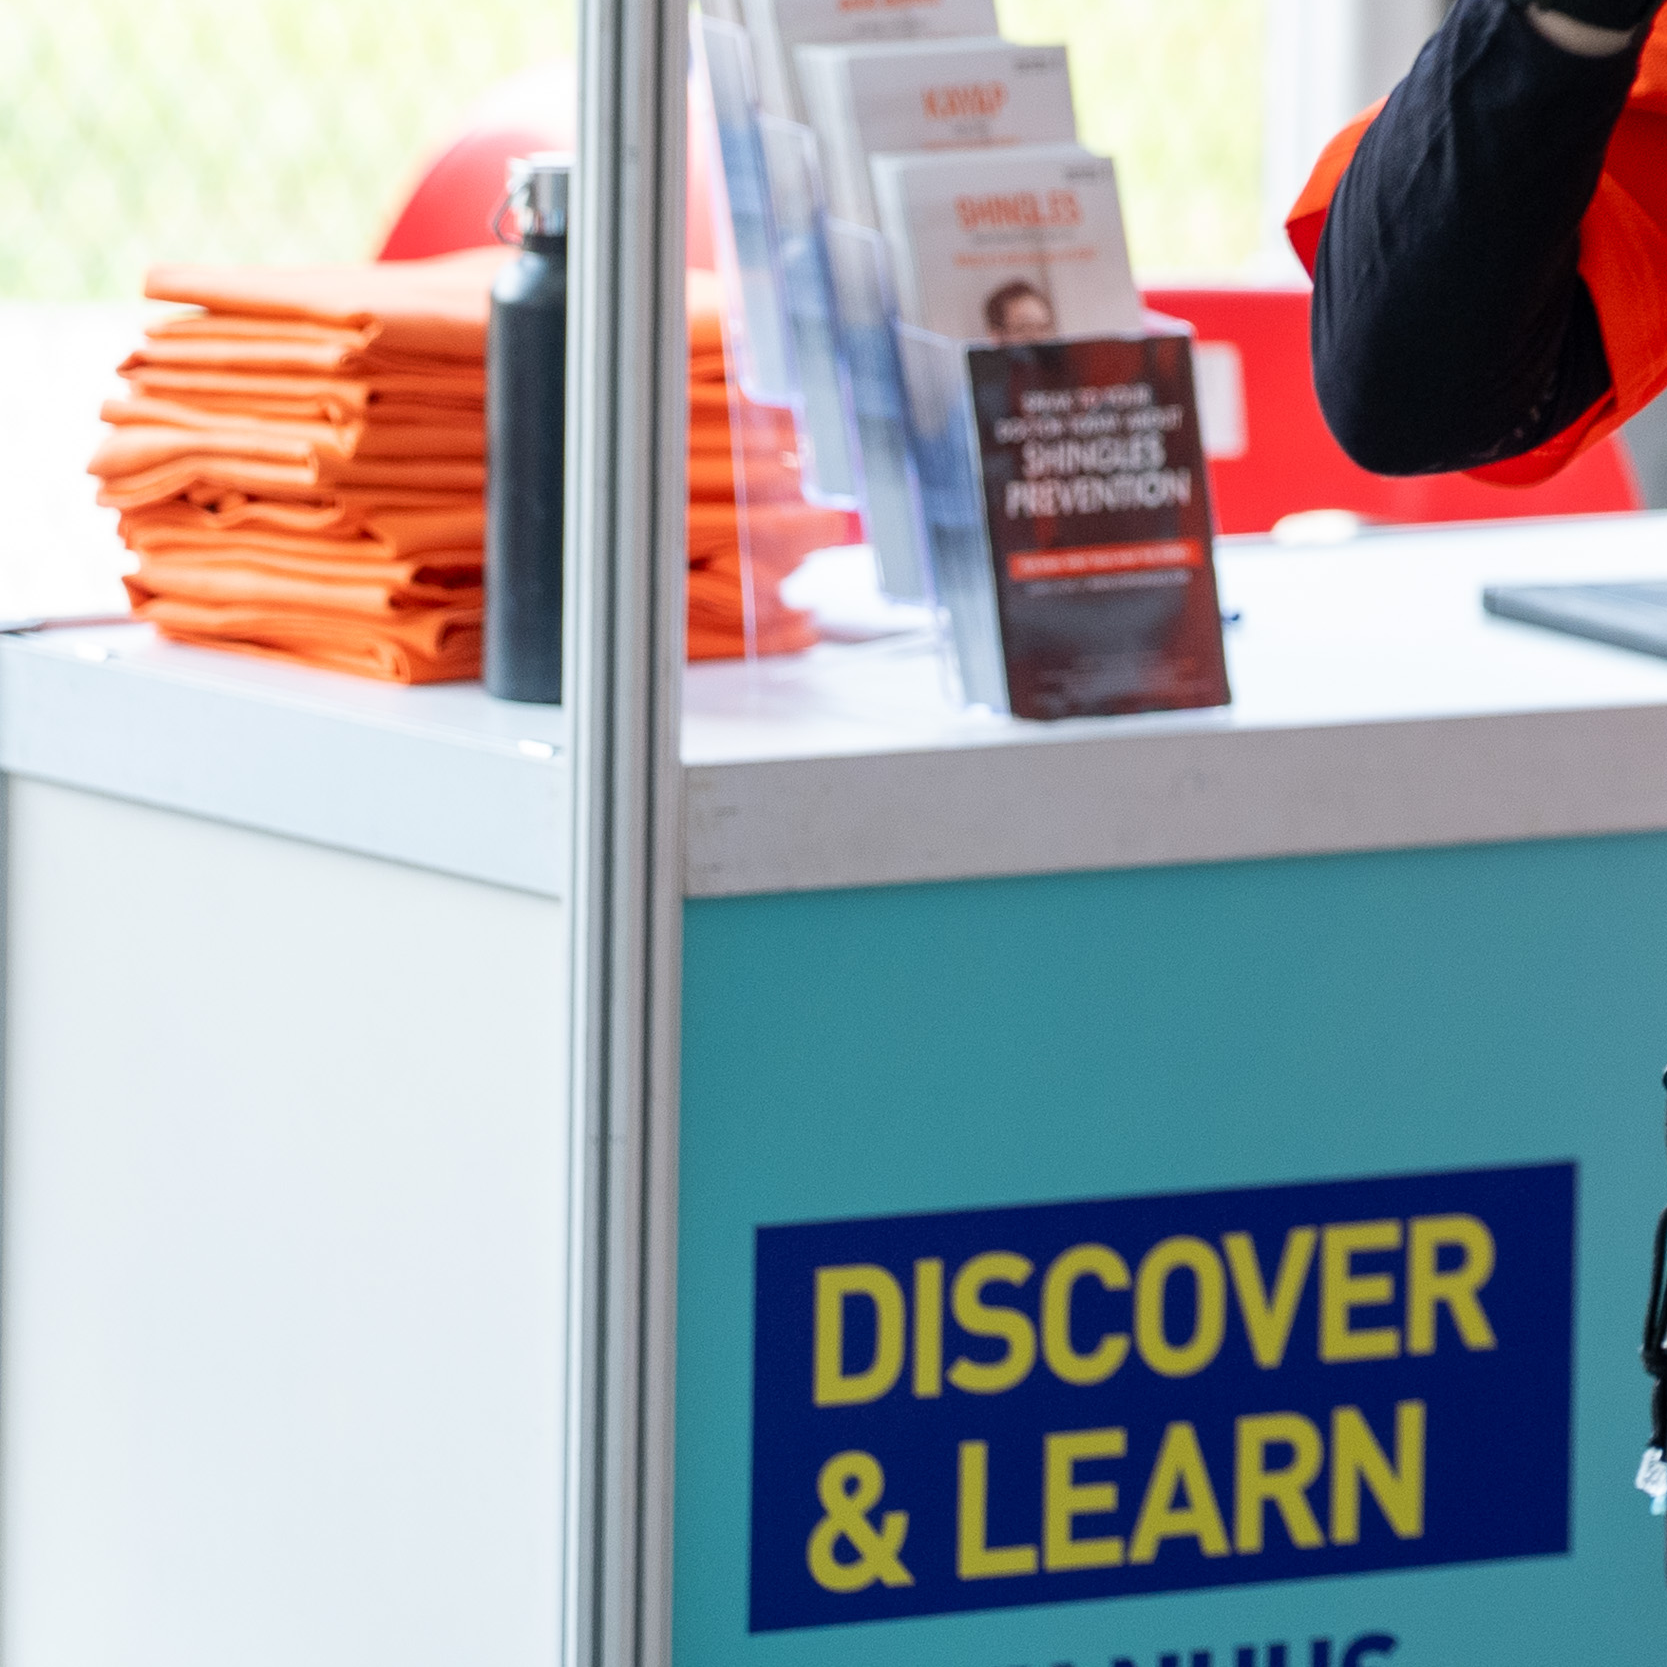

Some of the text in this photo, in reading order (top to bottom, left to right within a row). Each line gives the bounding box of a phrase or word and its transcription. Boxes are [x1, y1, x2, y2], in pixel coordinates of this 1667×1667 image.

[956, 190, 1082, 230] SHINGLES
[1023, 434, 1164, 476] SHINGLES
[1006, 469, 1190, 517] PREVENTION
[812, 1211, 1500, 1409] DISCOVER
[805, 1398, 1428, 1594] & LEARN
